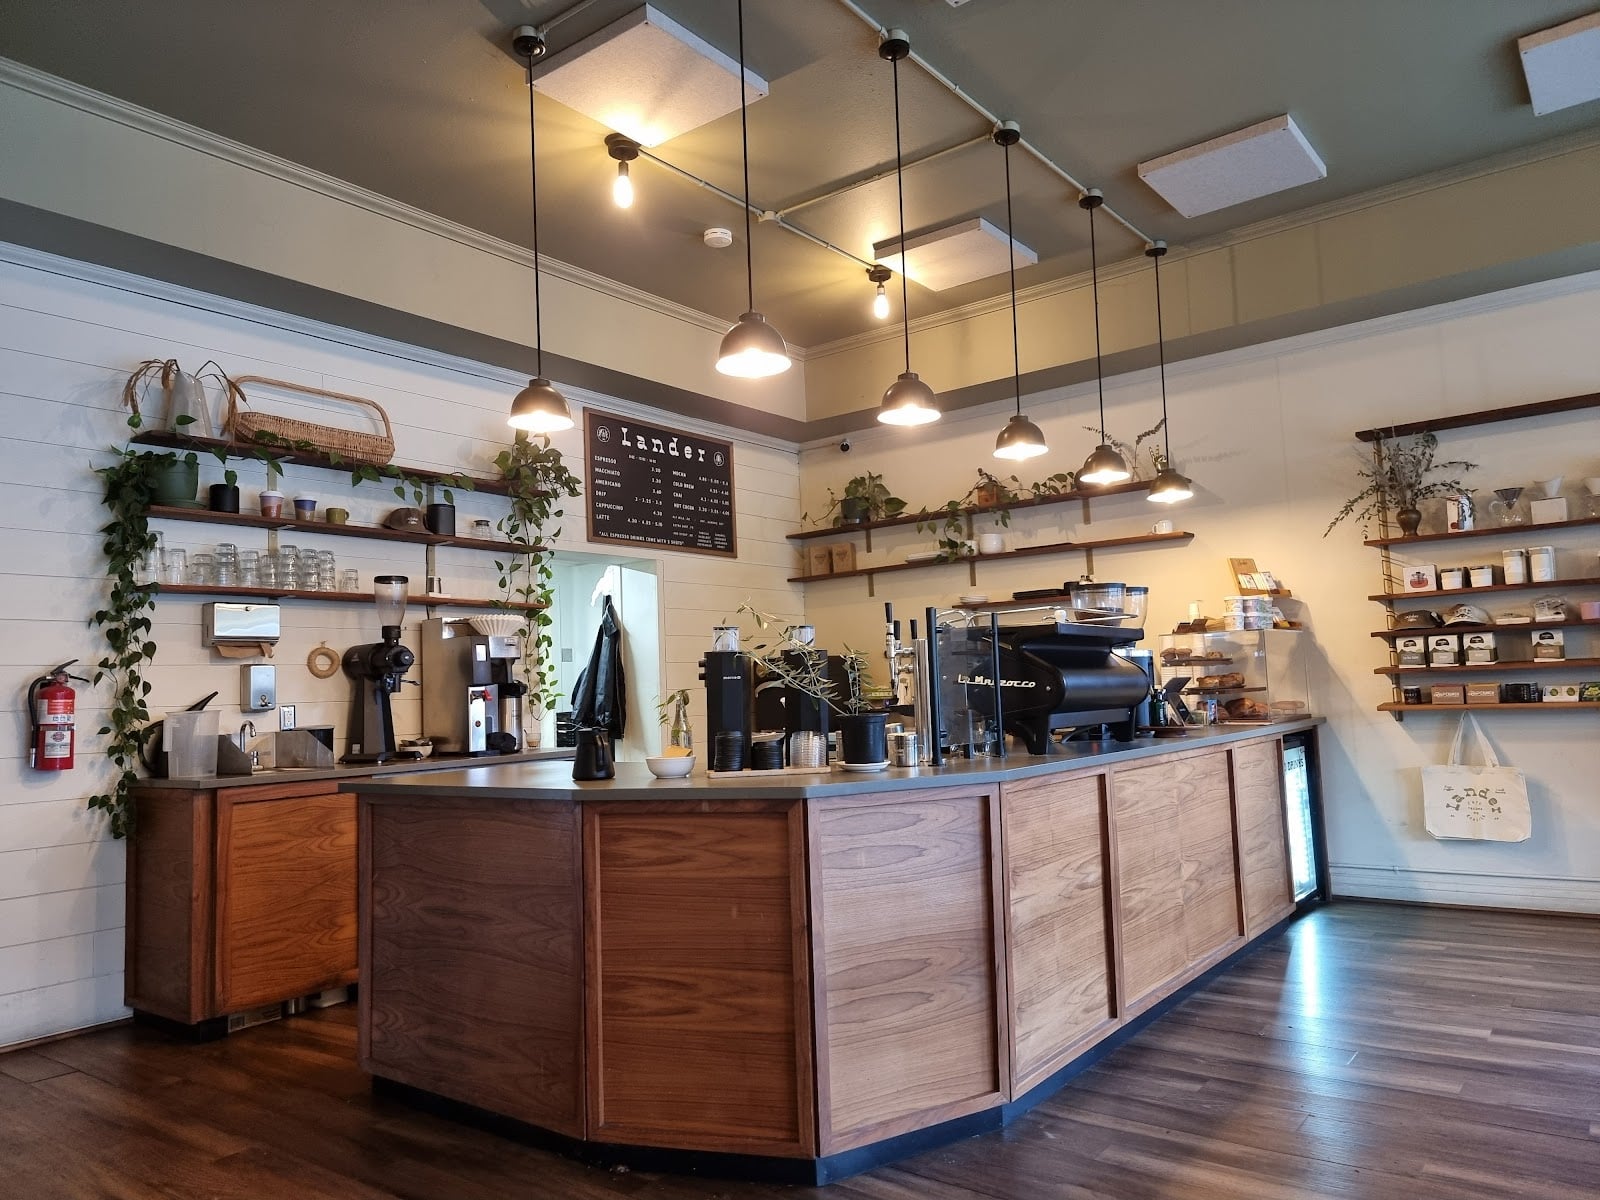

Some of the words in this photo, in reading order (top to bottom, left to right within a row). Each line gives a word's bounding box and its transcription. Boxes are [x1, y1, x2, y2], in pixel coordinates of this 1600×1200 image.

[621, 427, 705, 462] Lander
[595, 455, 616, 464] ESPRESSO
[595, 467, 621, 476] MACCHIATO
[595, 479, 621, 488] AMERICANO
[596, 502, 623, 510] CAPPUCCINO
[1446, 788, 1501, 814] Lander
